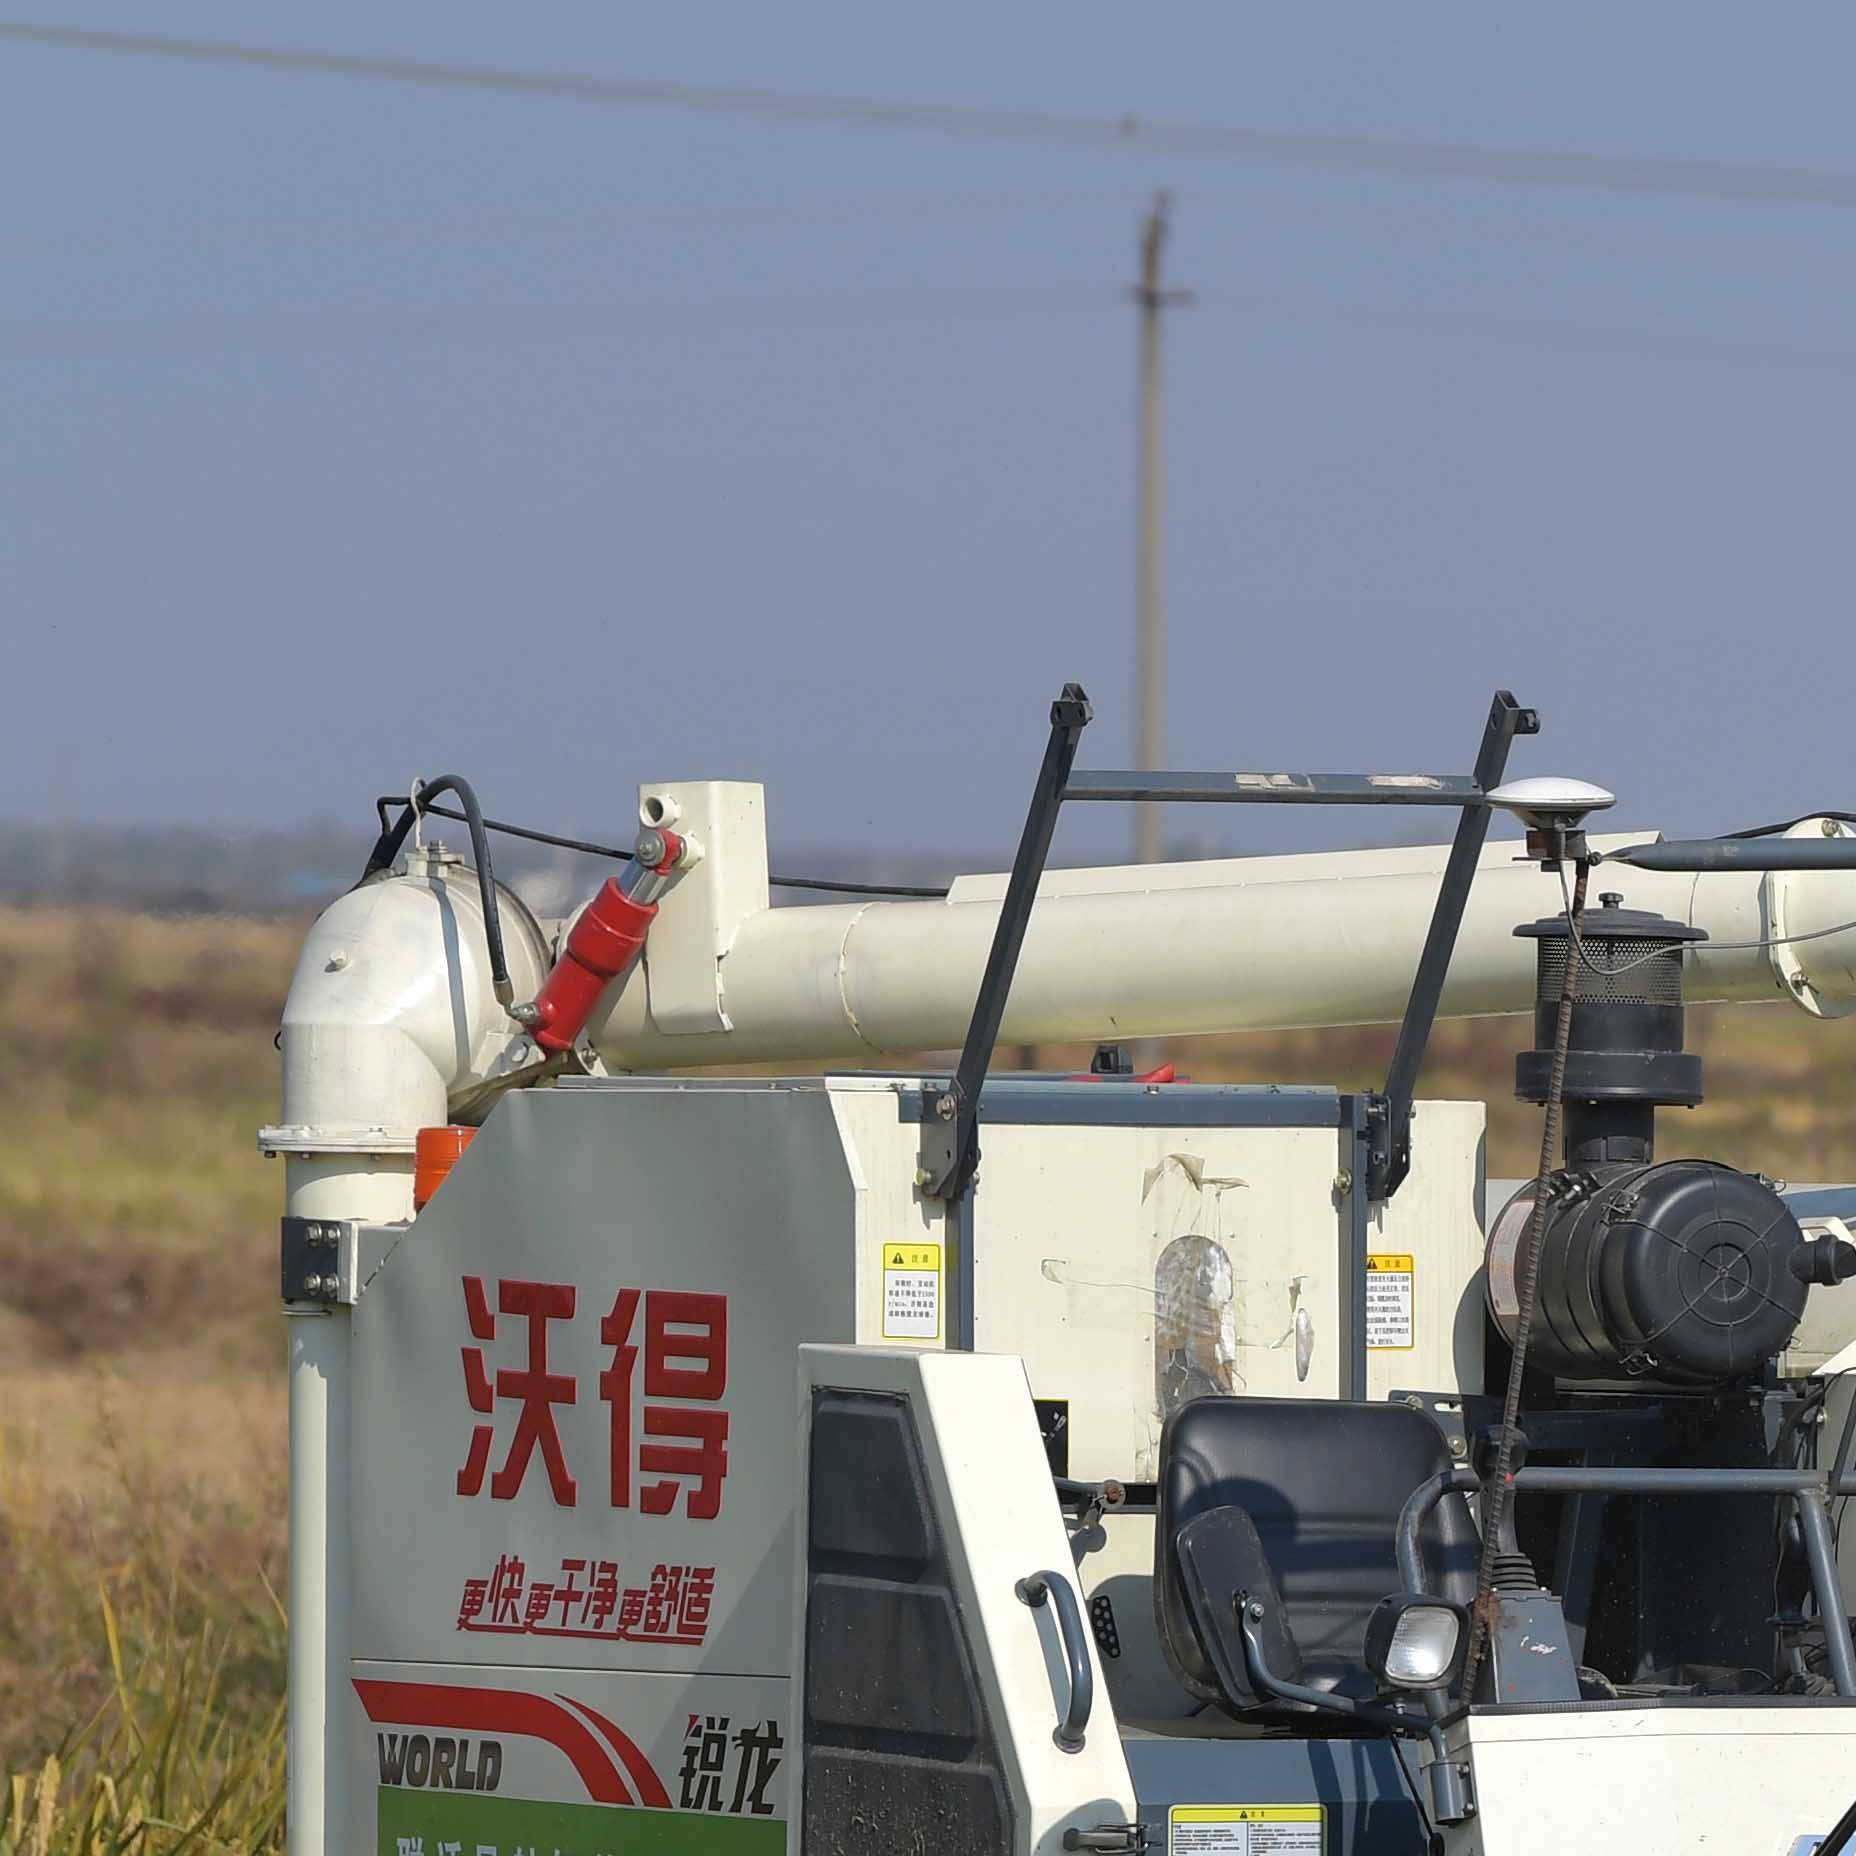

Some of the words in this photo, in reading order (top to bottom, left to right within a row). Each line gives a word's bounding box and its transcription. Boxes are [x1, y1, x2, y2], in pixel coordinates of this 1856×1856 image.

[457, 1275, 728, 1520] 沃得
[455, 1554, 716, 1646] 更快更干净更舒适
[377, 1732, 502, 1792] WORLD
[678, 1714, 784, 1815] 锐龙
